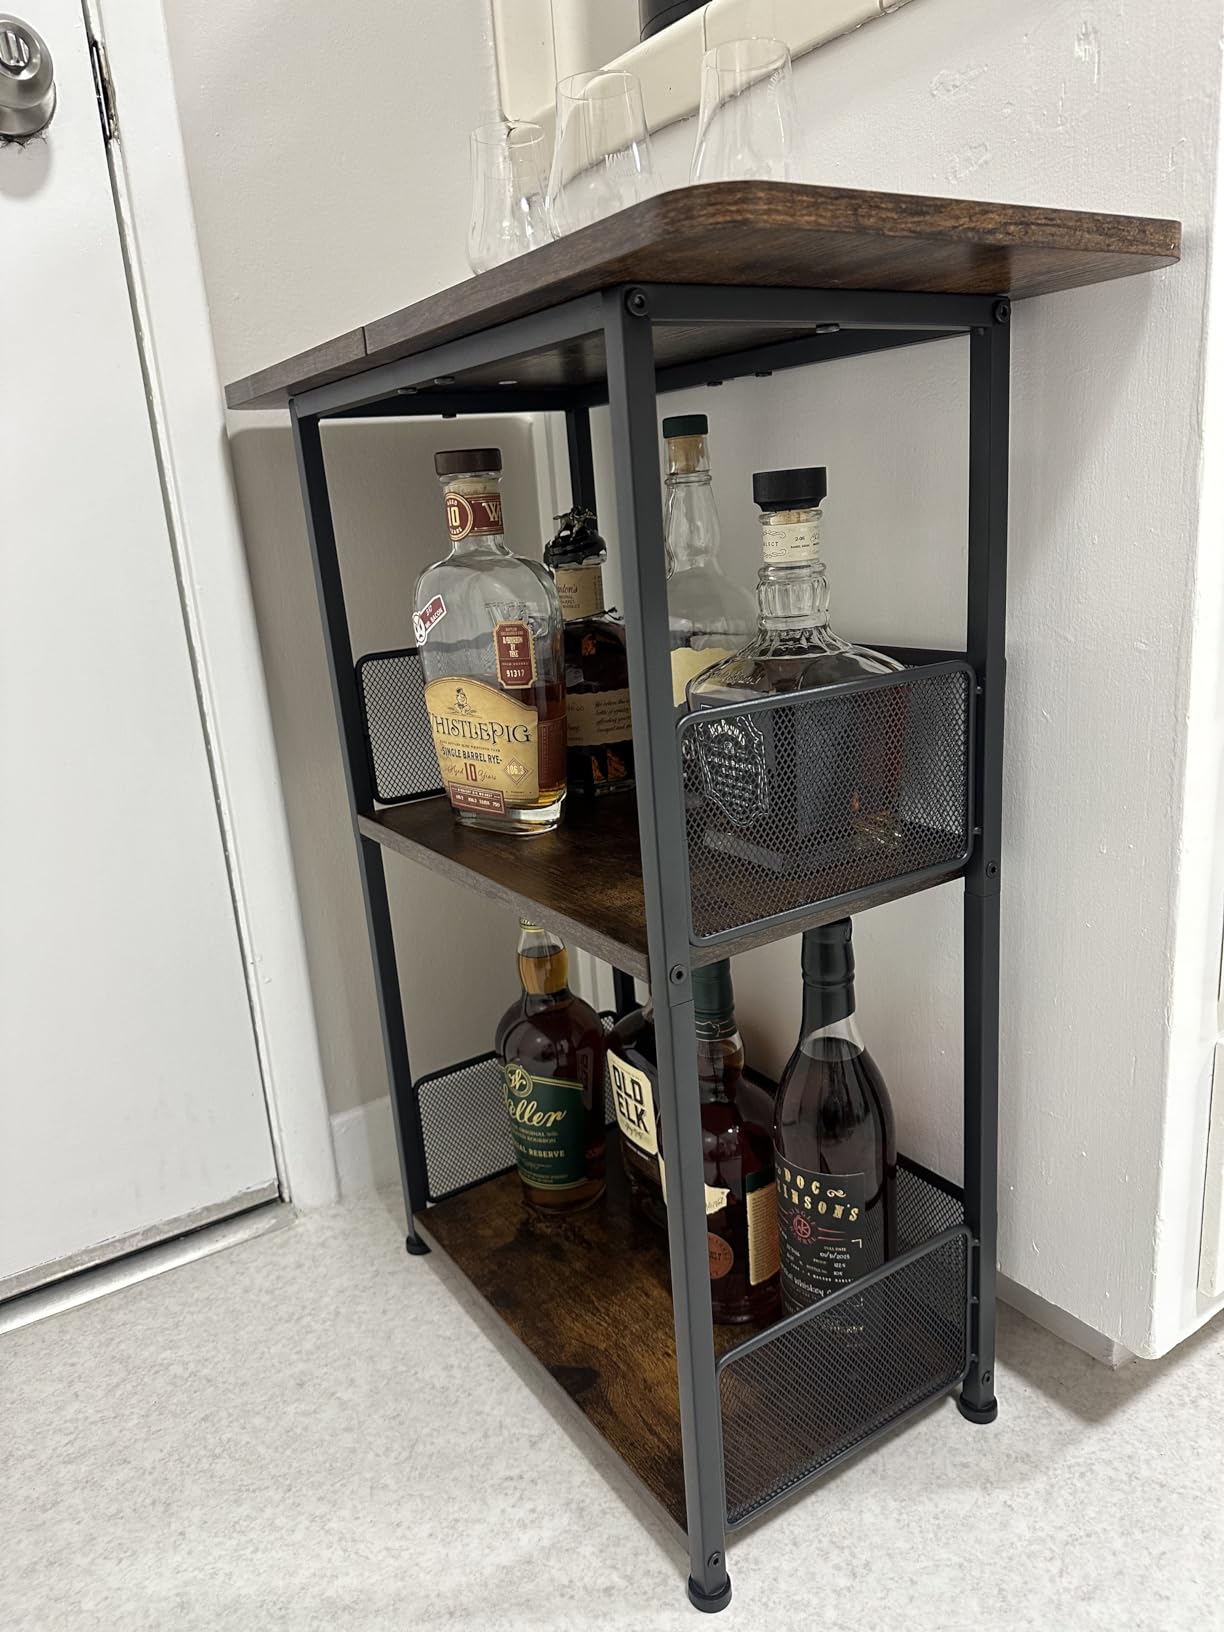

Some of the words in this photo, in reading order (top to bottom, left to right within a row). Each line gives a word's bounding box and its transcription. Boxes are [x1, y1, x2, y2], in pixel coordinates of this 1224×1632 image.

[446, 506, 460, 527] 10
[430, 713, 532, 745] HISTLEPIG
[442, 746, 462, 758] SINGLE
[462, 750, 487, 763] BARREL
[464, 762, 478, 782] 10
[612, 1063, 644, 1106] OLD
[616, 1090, 650, 1135] ELK
[528, 1148, 566, 1159] RESERVE
[783, 1167, 820, 1195] DOC
